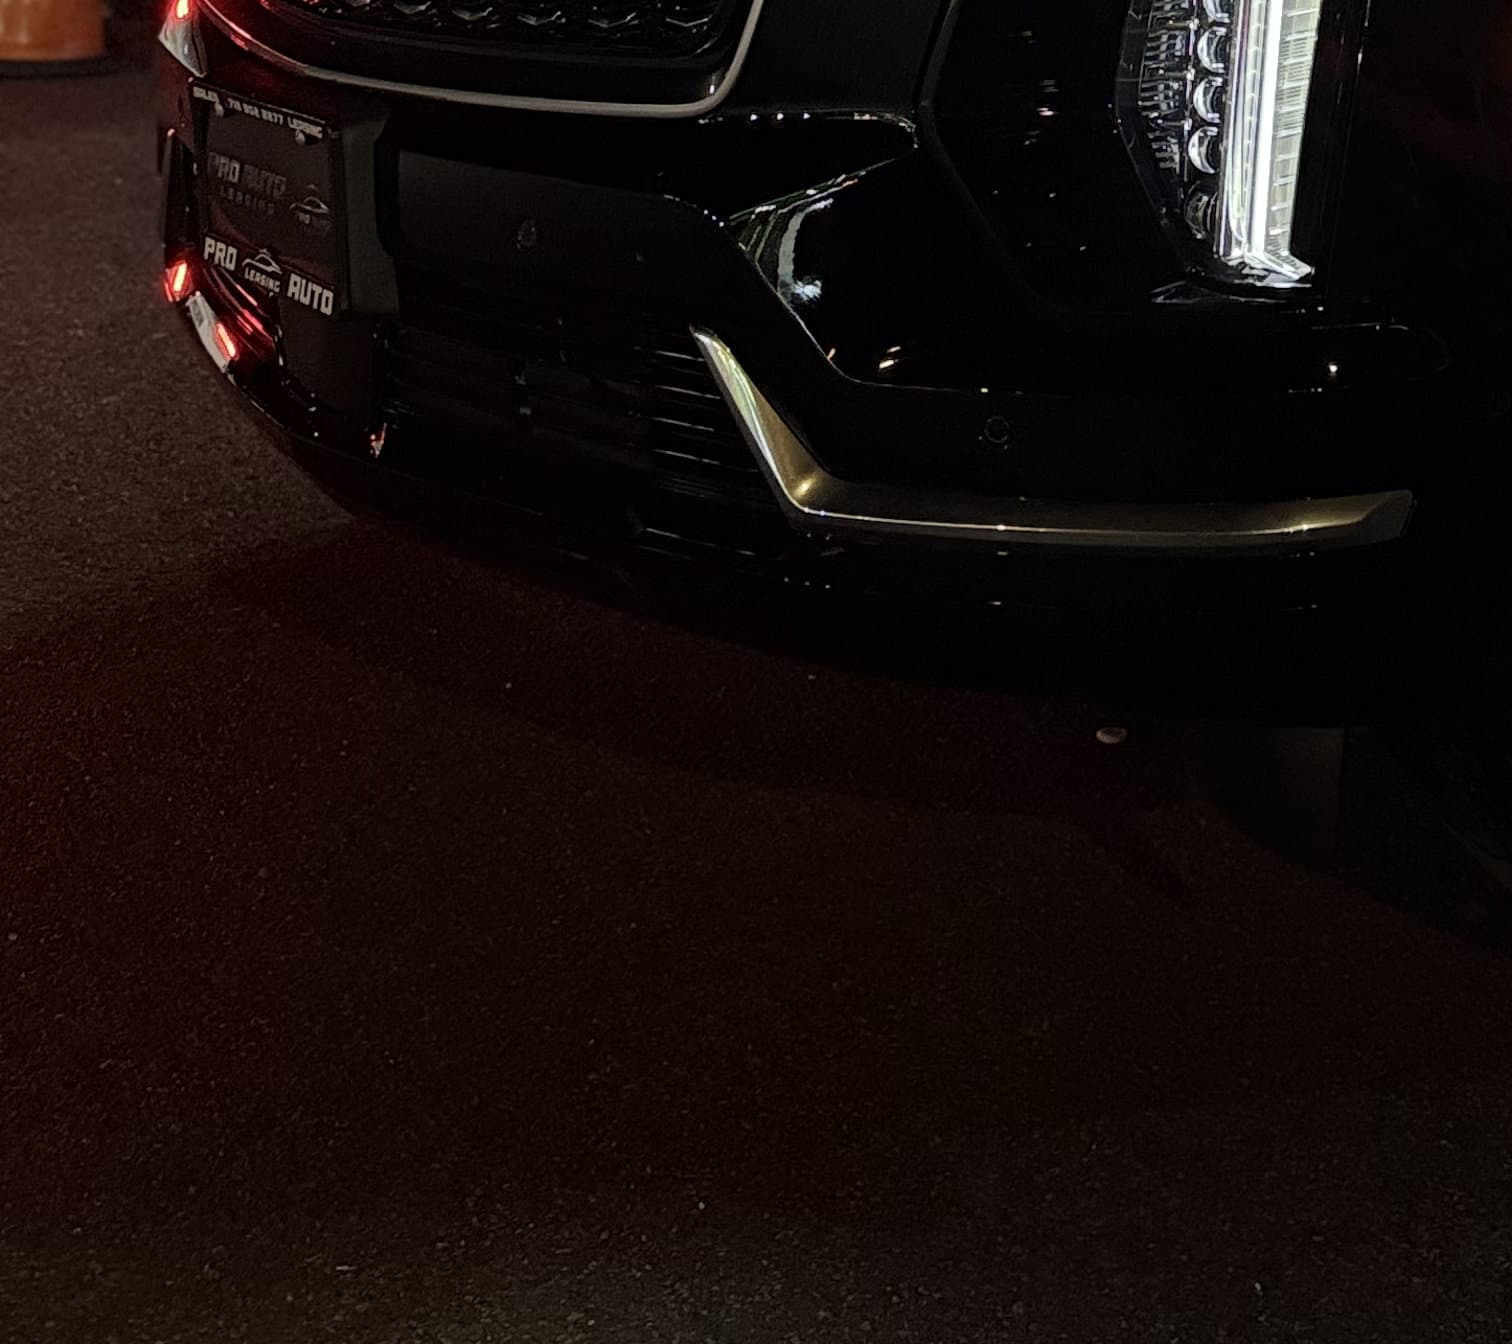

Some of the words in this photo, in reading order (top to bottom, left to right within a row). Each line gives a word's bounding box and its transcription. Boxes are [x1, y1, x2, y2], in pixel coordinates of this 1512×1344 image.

[203, 235, 239, 272] PRO
[244, 266, 281, 294] LEASING
[286, 272, 335, 317] AUTO
